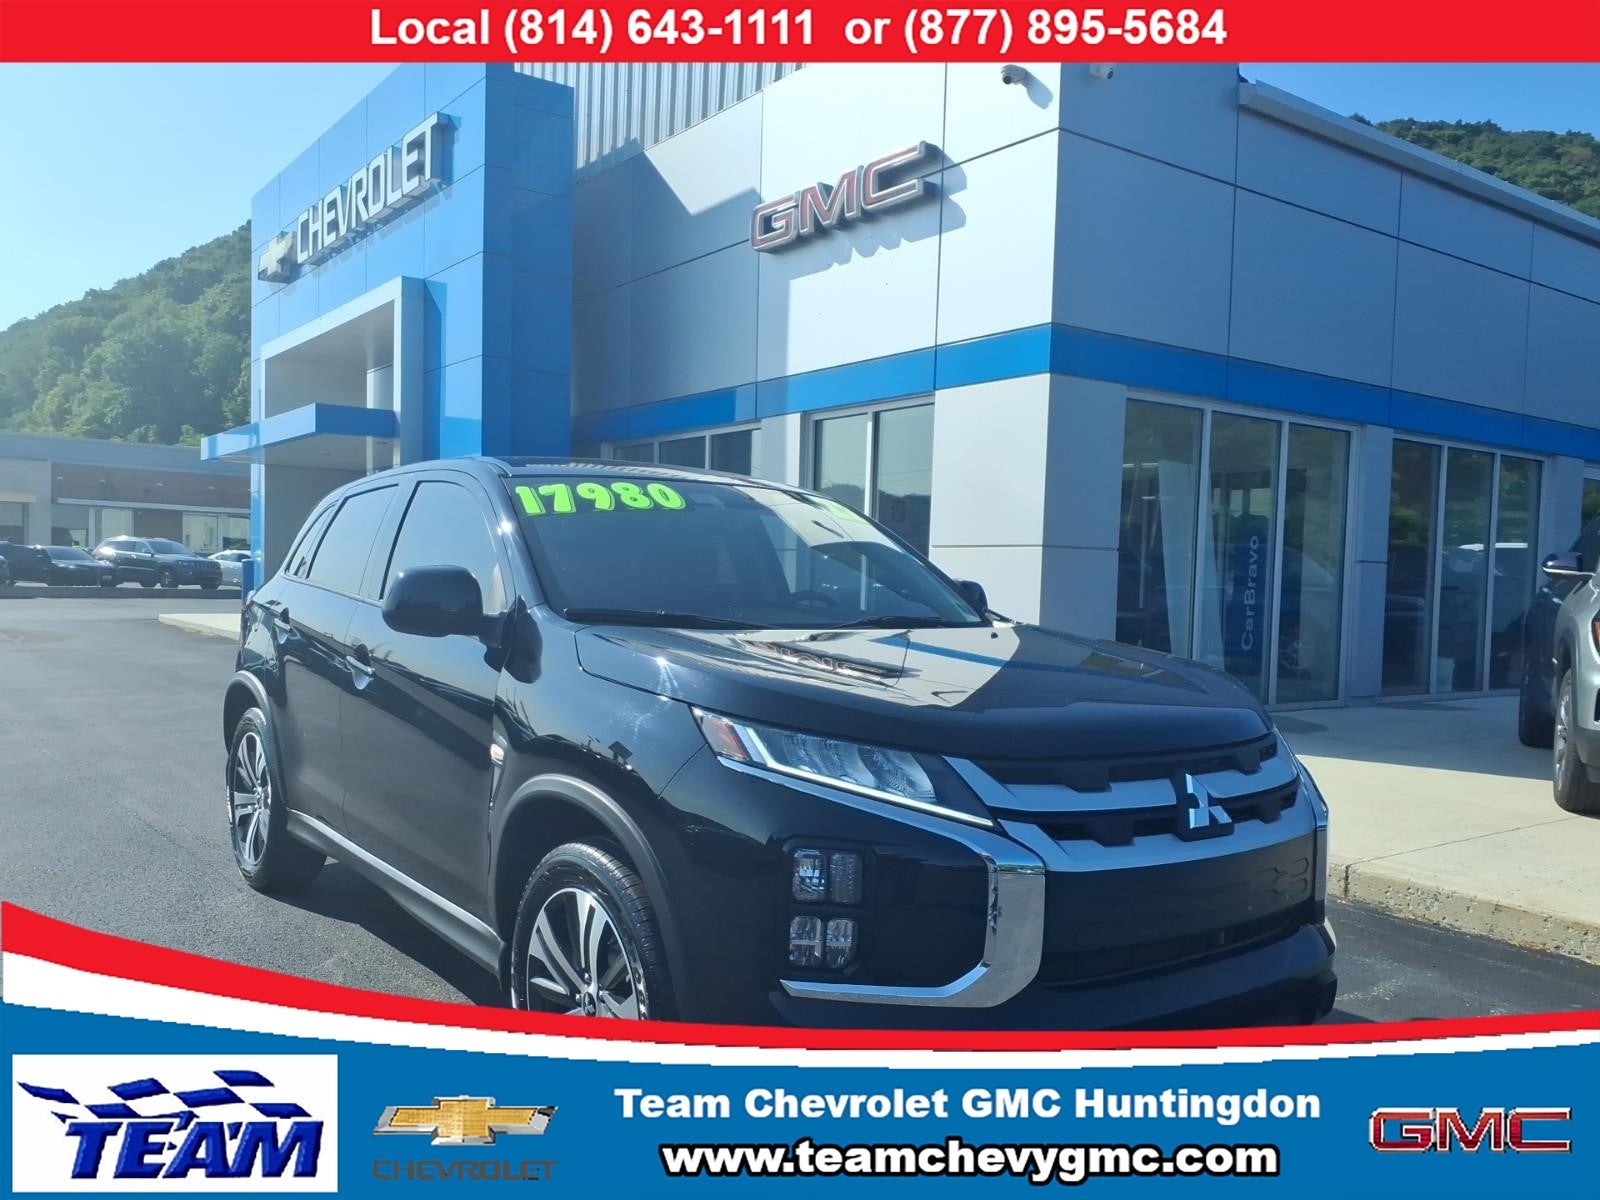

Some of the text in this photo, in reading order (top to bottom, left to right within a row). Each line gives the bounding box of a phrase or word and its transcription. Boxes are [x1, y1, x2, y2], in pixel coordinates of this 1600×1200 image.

[297, 111, 445, 265] CHEVROLET
[750, 141, 926, 251] GMC
[515, 482, 686, 516] 17980
[1241, 535, 1260, 650] CarBravo
